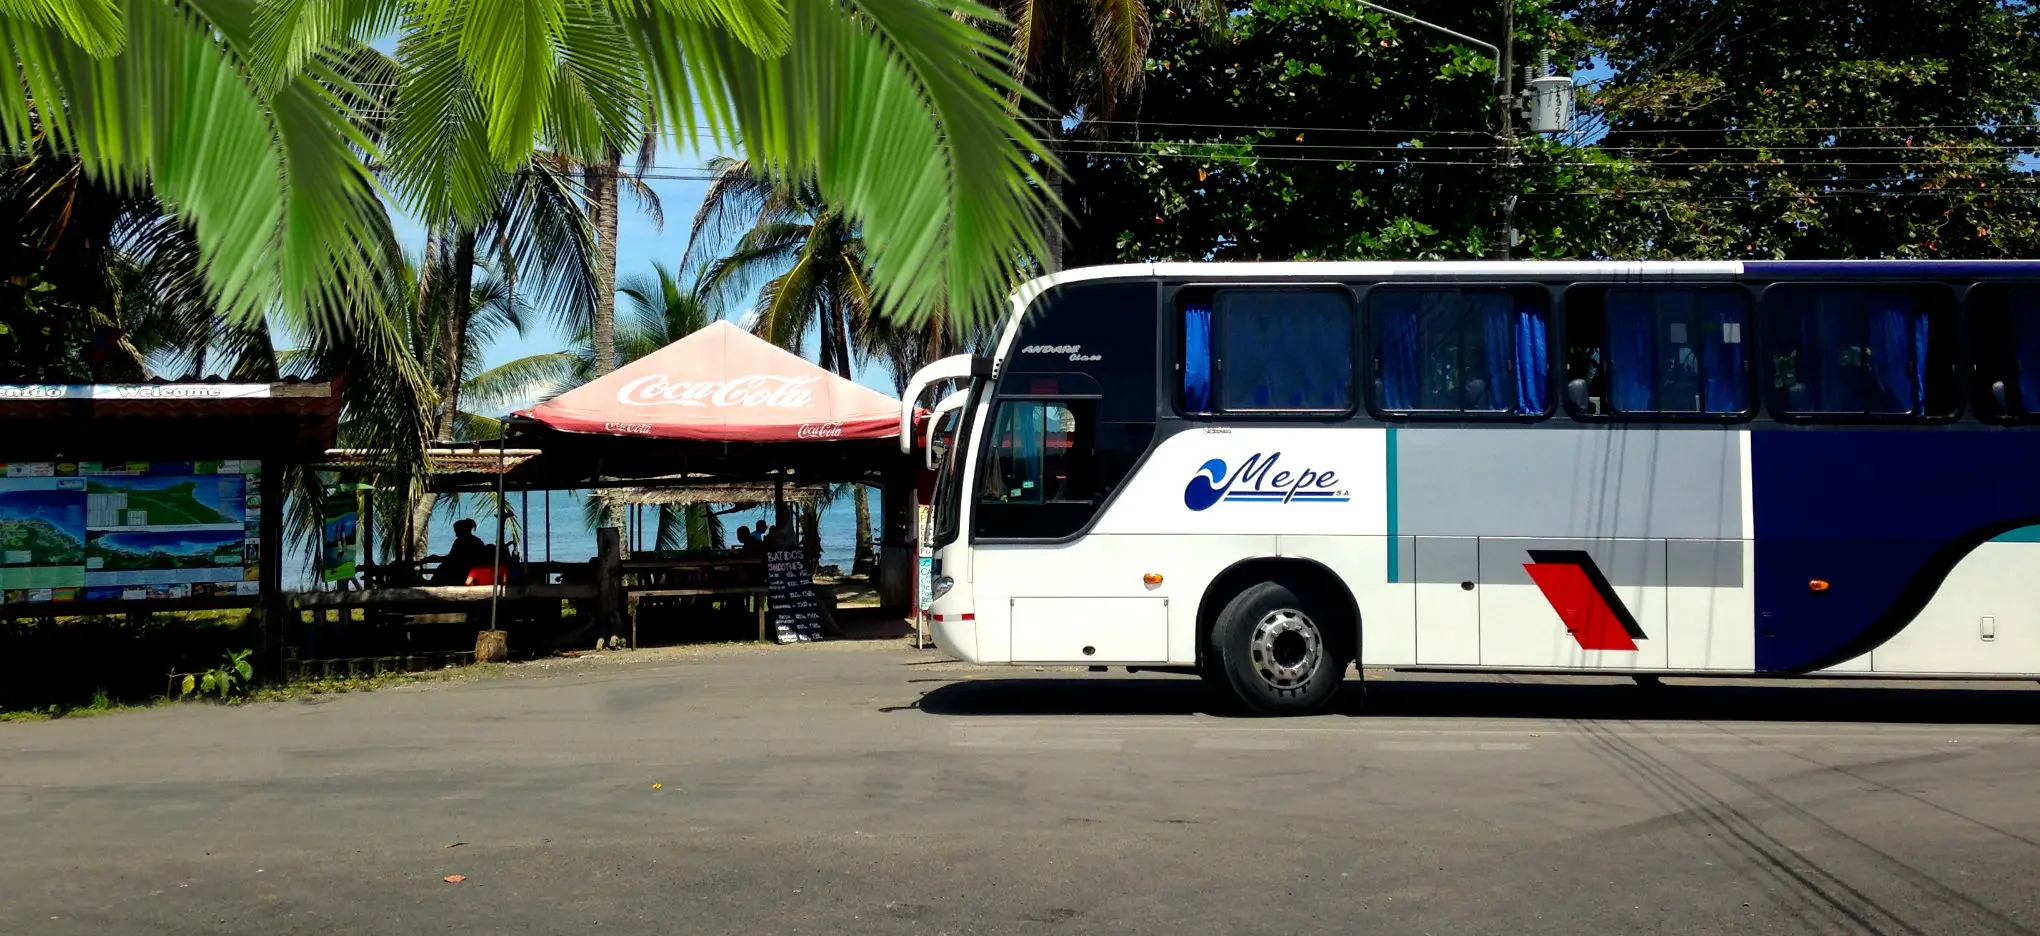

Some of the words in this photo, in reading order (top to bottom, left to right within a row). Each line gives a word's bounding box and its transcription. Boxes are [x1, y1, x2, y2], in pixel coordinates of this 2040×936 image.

[1021, 344, 1081, 354] ANDARE
[116, 385, 221, 398] Welcome
[1227, 451, 1339, 504] Mepe
